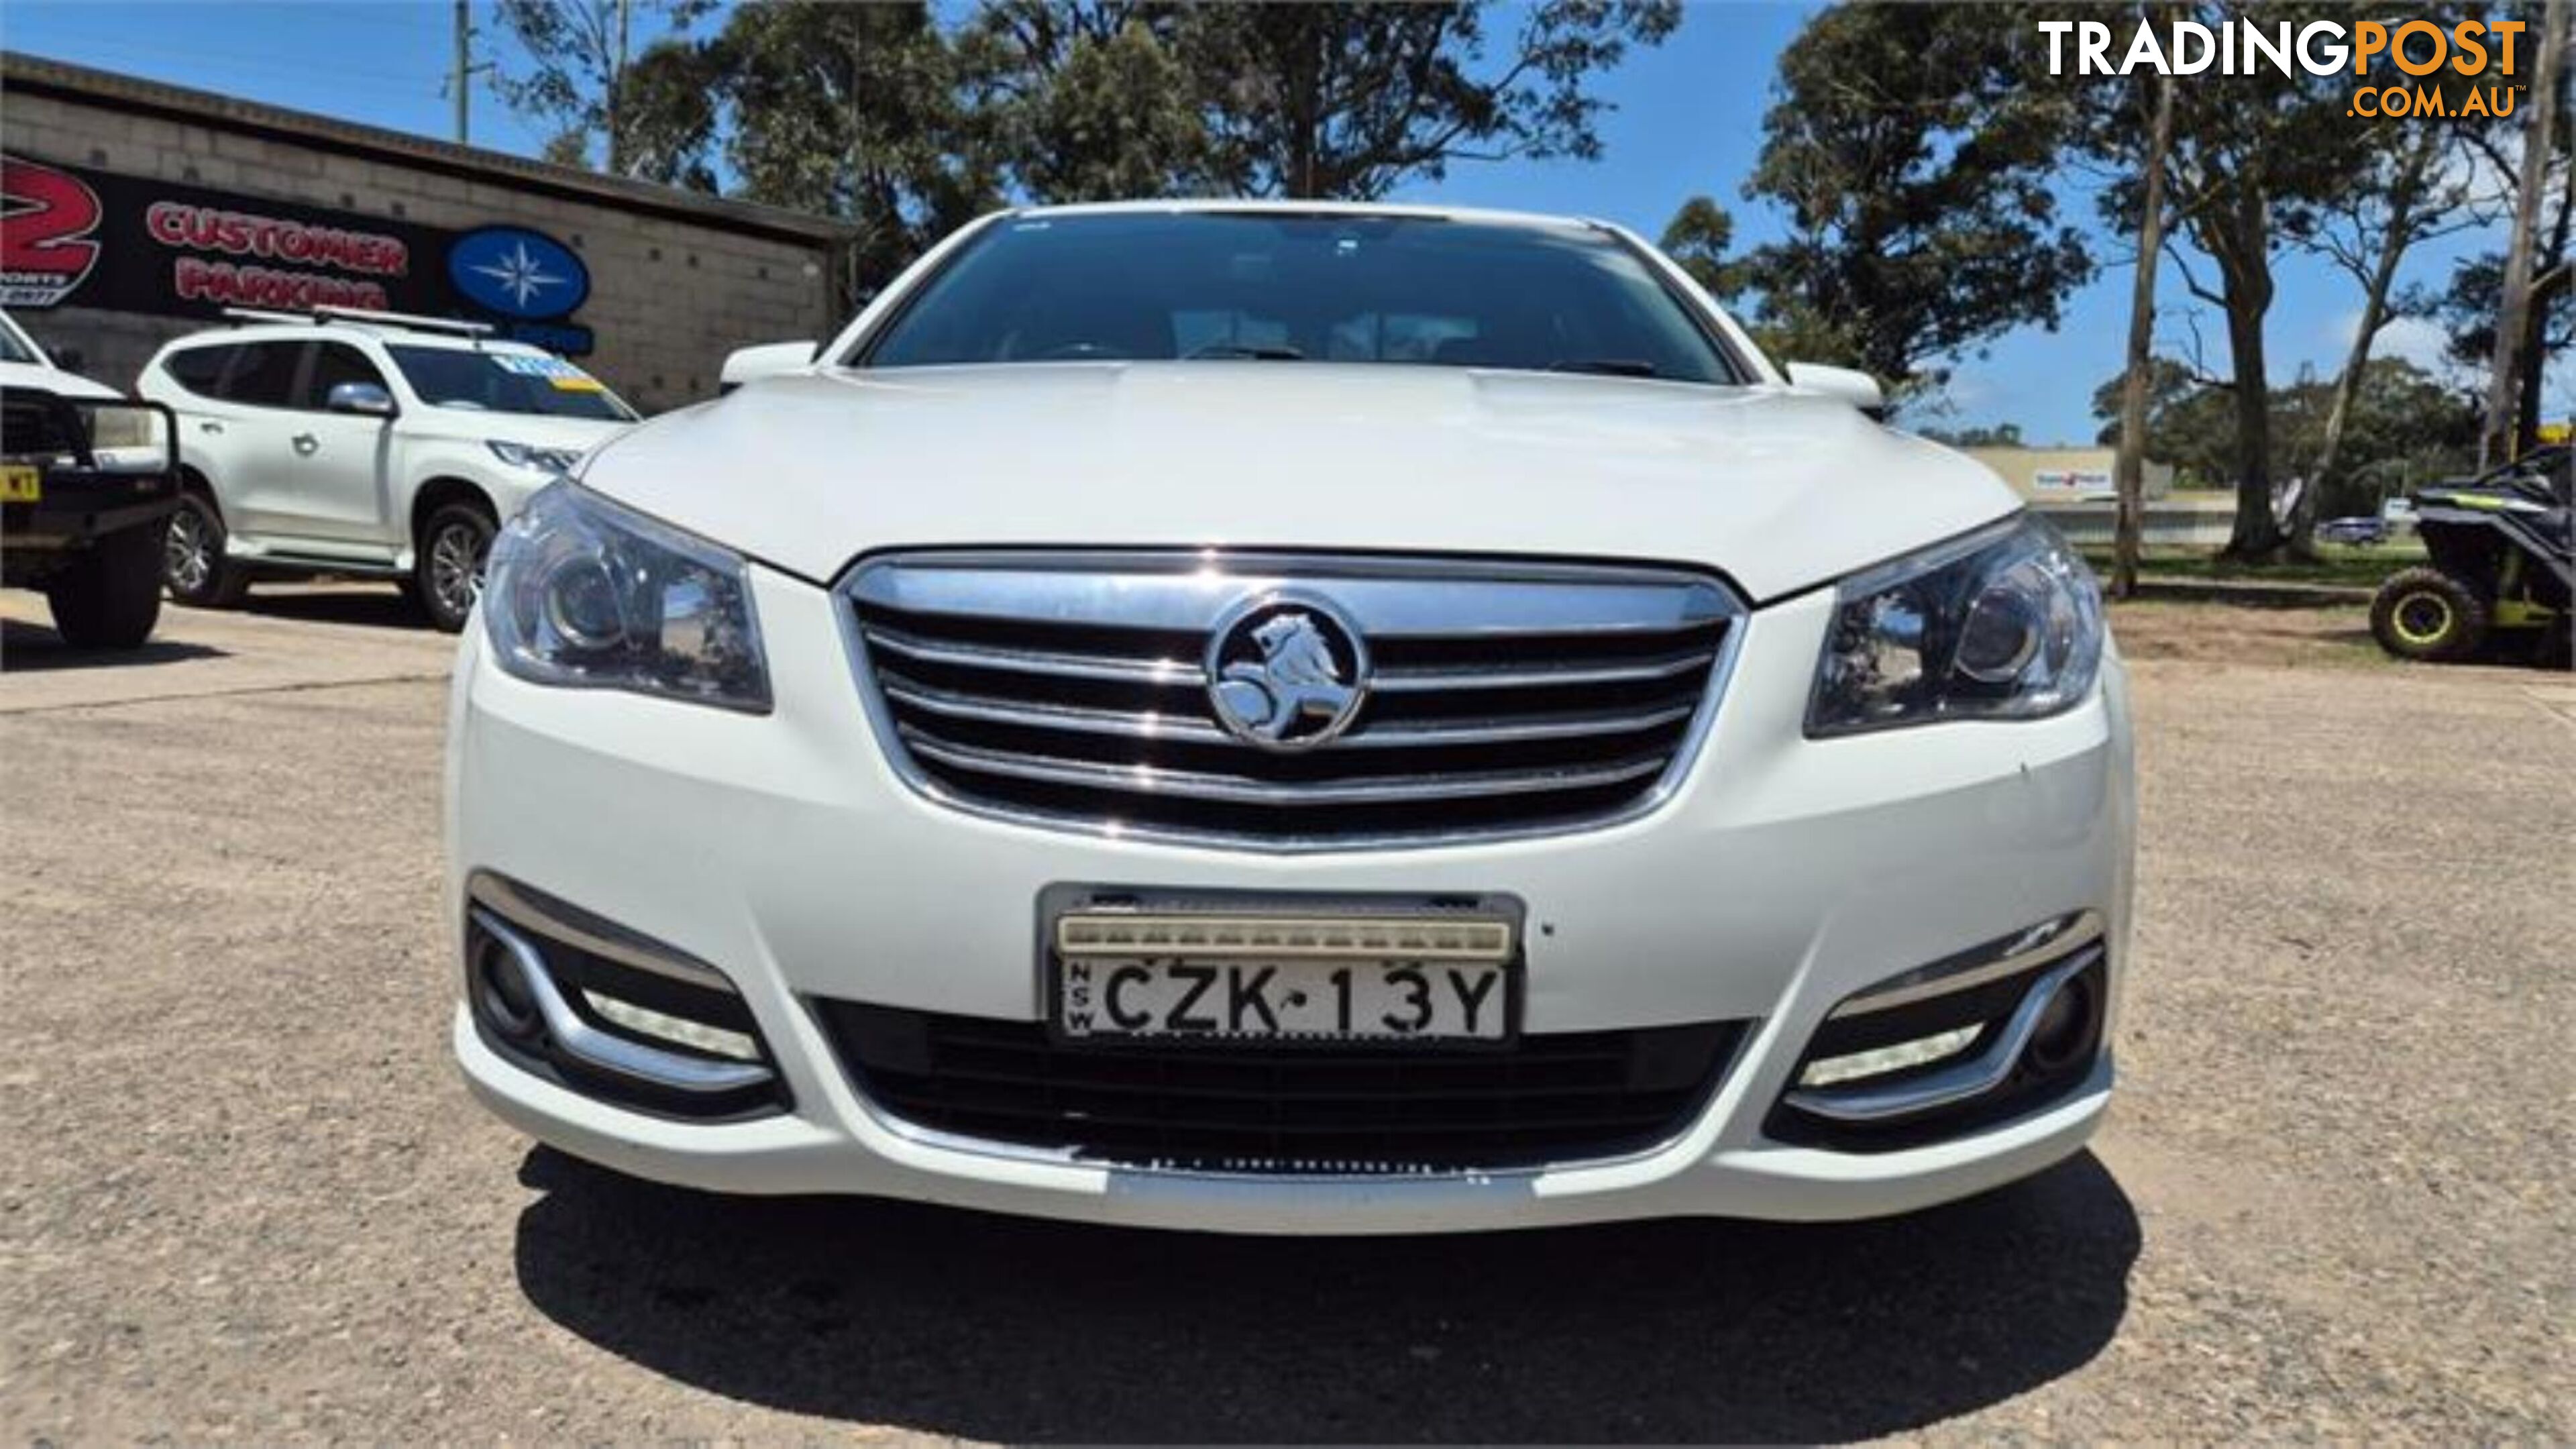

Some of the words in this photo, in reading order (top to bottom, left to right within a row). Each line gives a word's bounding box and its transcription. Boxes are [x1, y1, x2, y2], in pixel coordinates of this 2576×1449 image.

[147, 201, 409, 276] CUSTOMER
[175, 256, 389, 310] PARKING
[1067, 962, 1094, 1030] NSW
